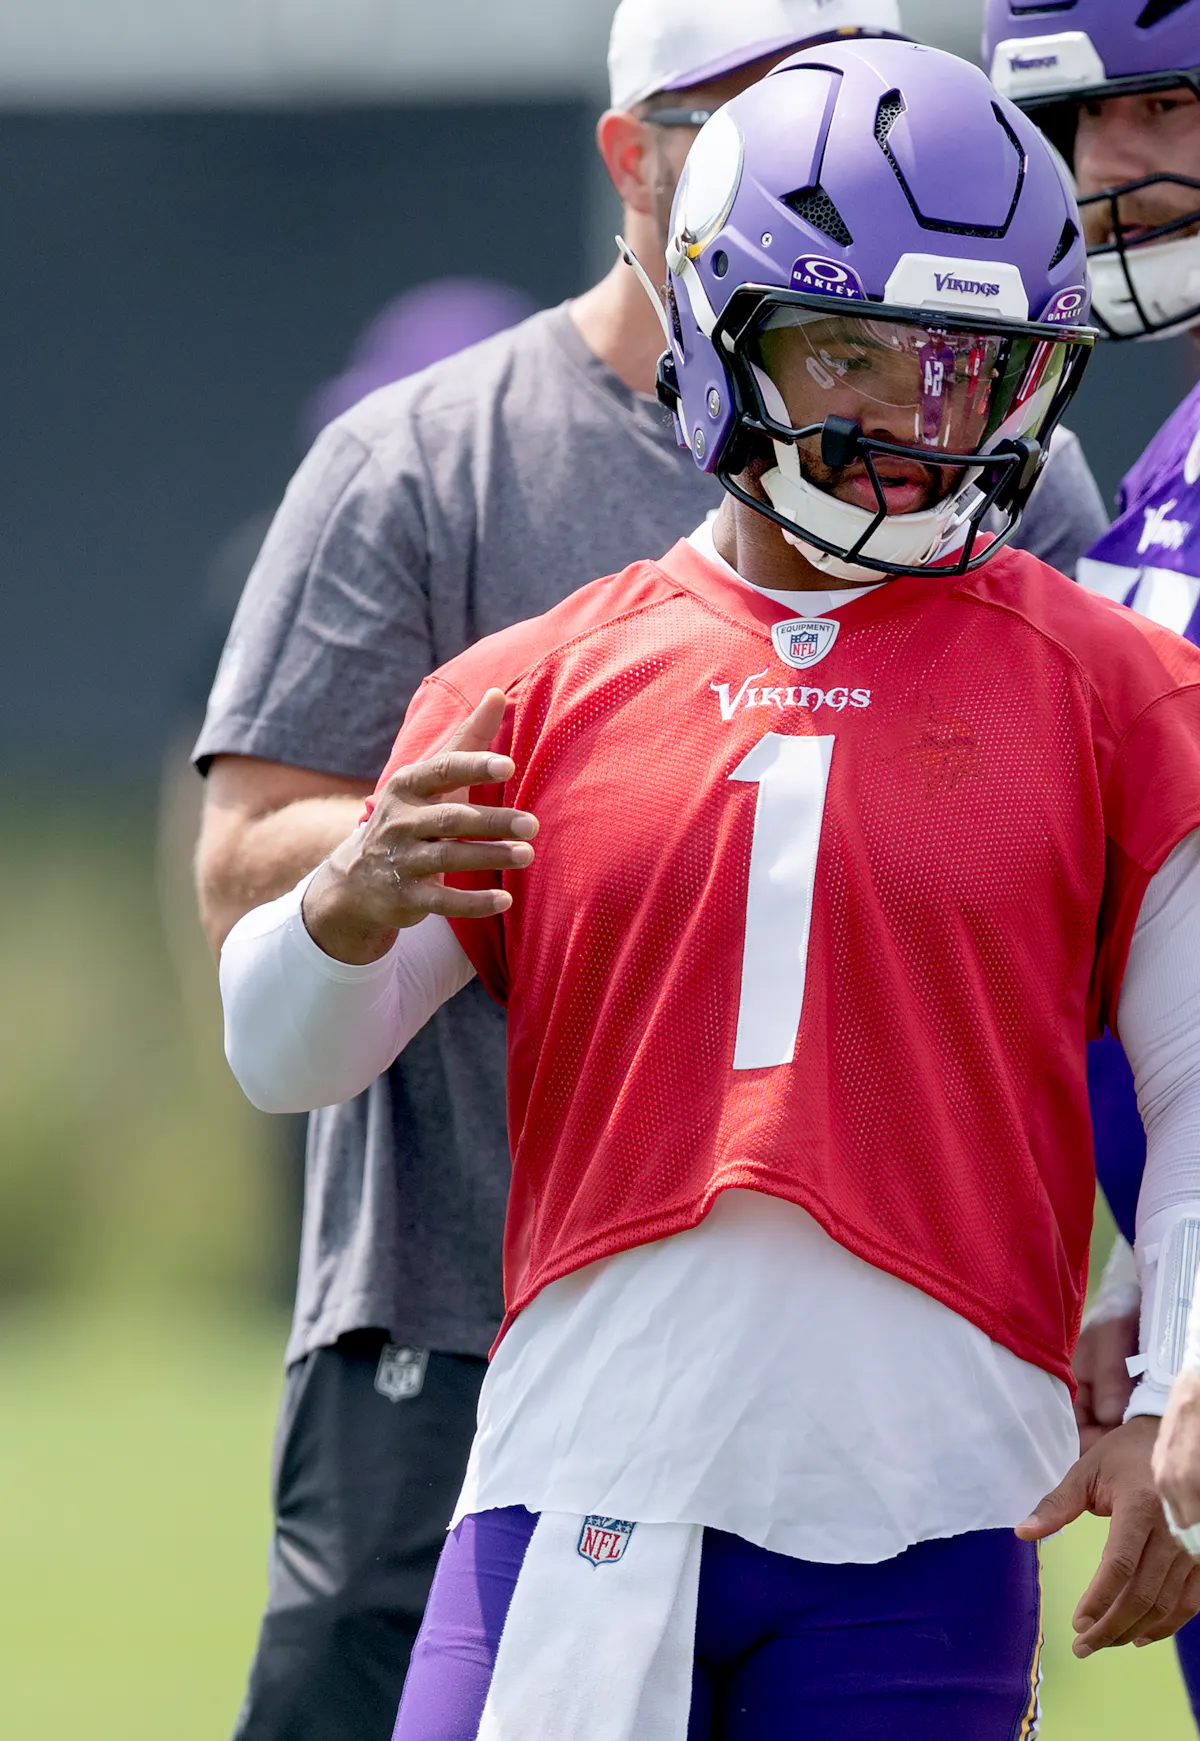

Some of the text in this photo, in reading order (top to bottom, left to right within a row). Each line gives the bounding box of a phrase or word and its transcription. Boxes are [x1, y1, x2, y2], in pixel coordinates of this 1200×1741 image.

[793, 271, 855, 297] OAKLEY
[780, 623, 831, 634] EQUIPMENT
[792, 642, 815, 657] NFL
[727, 730, 836, 1070] 1
[581, 1526, 621, 1560] NFL
